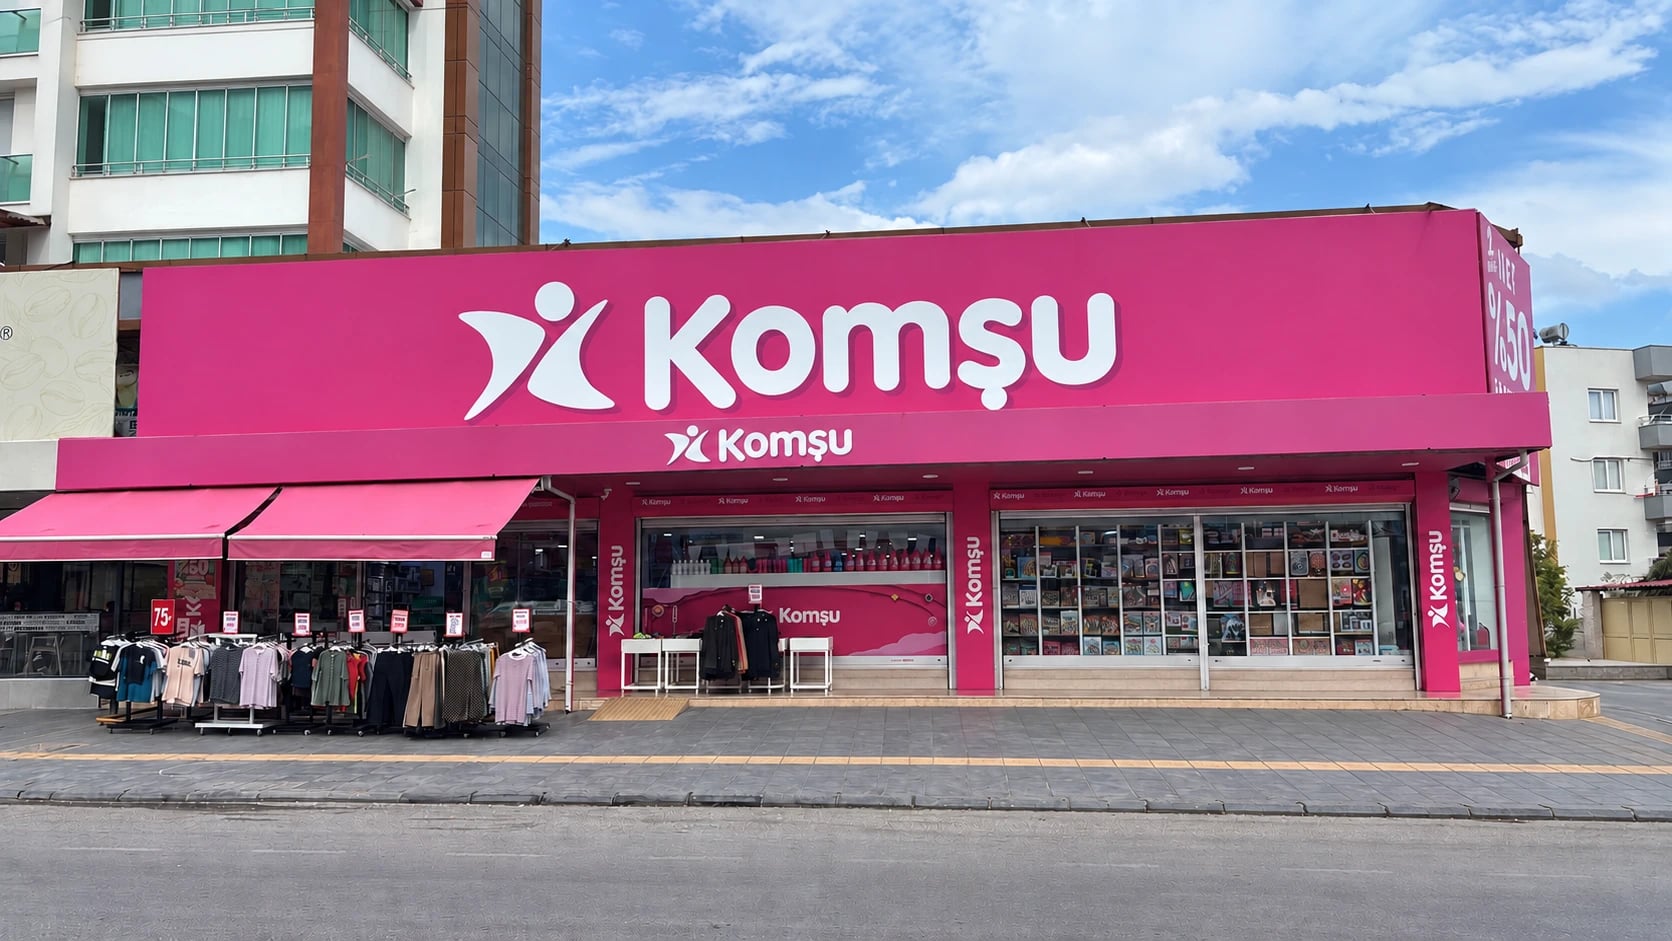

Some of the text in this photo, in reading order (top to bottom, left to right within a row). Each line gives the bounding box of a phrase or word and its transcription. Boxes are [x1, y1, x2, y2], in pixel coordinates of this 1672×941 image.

[643, 291, 1118, 411] Komşu
[1487, 281, 1531, 392] %50
[718, 427, 853, 463] Komşu
[607, 544, 627, 611] Komşu
[965, 535, 984, 607] Komşu
[1428, 529, 1447, 600] Komşu
[778, 607, 841, 626] Komşu
